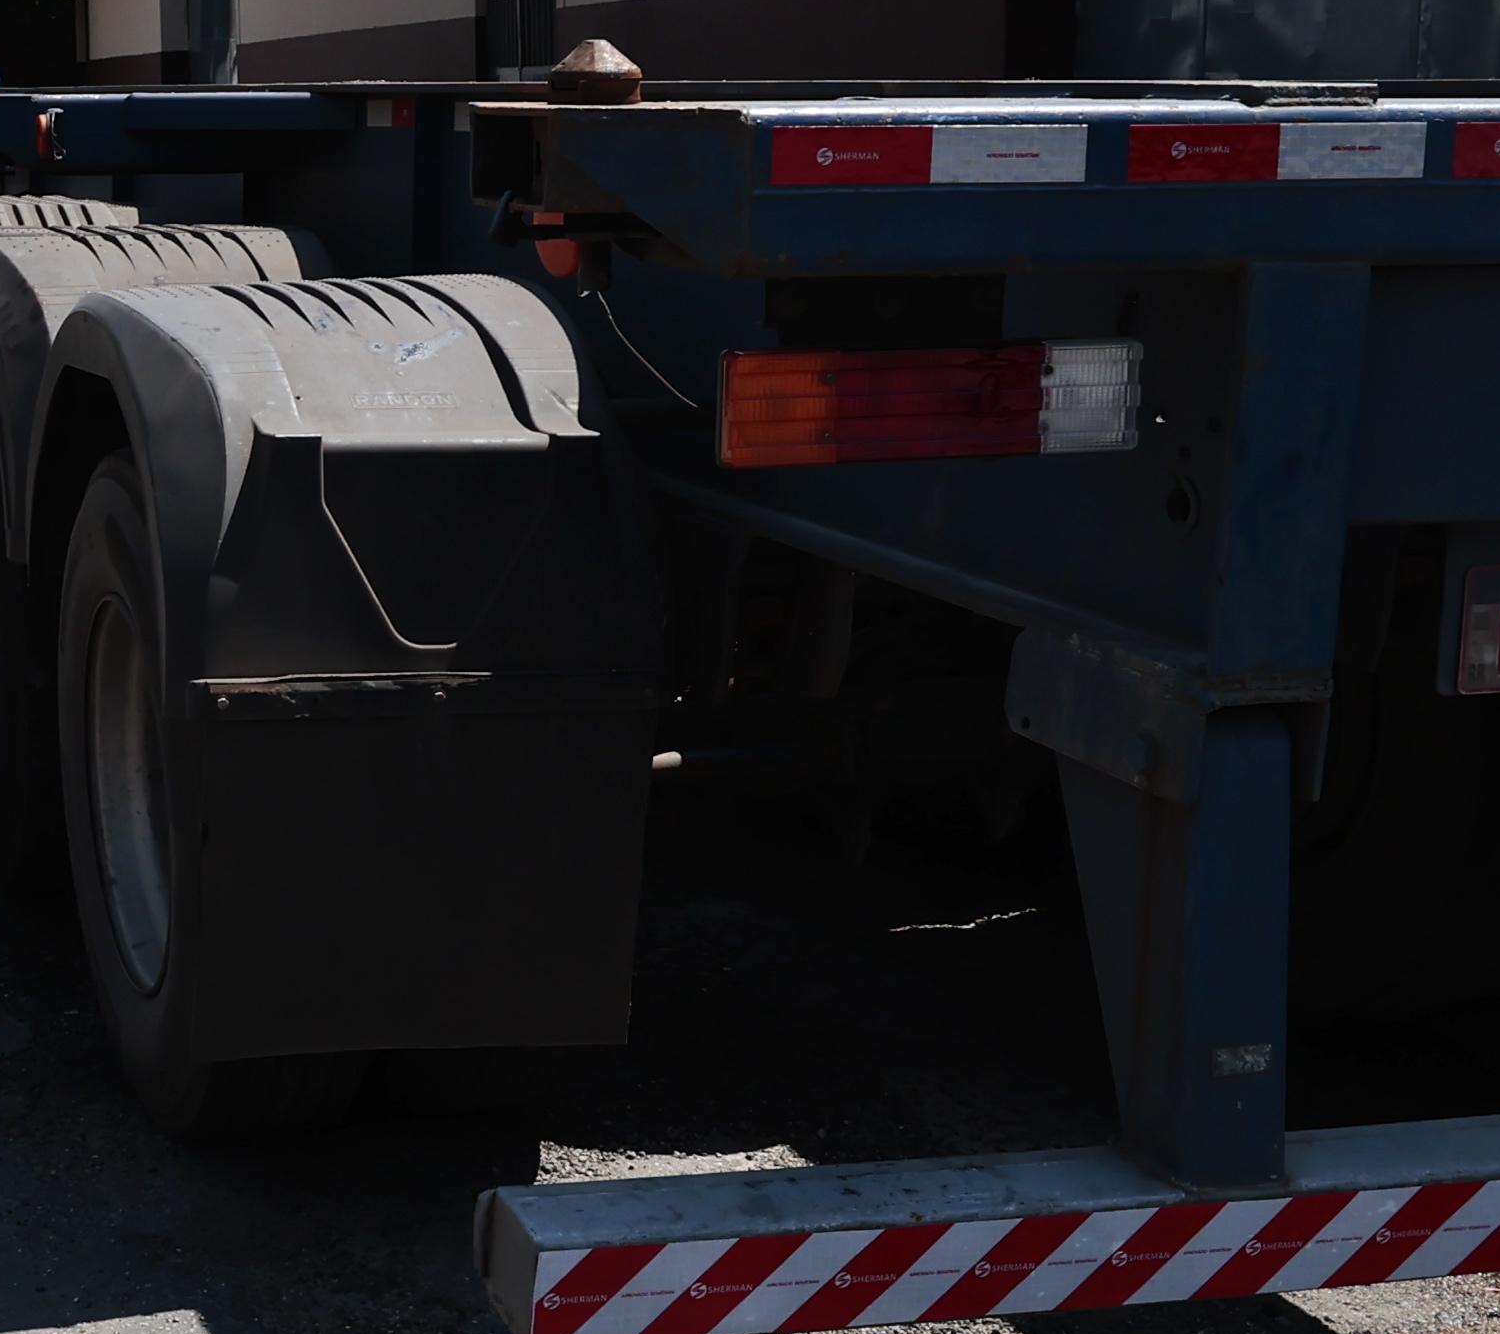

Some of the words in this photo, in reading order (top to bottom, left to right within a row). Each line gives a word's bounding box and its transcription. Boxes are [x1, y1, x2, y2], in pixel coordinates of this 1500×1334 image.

[834, 151, 880, 161] SHERMAN
[1187, 145, 1231, 155] SHERMAN
[356, 393, 452, 406] RANDON
[1391, 1228, 1432, 1240] SHERMAN
[1261, 1239, 1304, 1251] SHERMAN
[1127, 1251, 1172, 1263] SHERMAN
[991, 1262, 1036, 1274] SHERMAN
[851, 1273, 897, 1285] SHERMAN
[707, 1283, 754, 1295] SHERMAN
[560, 1294, 608, 1306] SHERMAN
